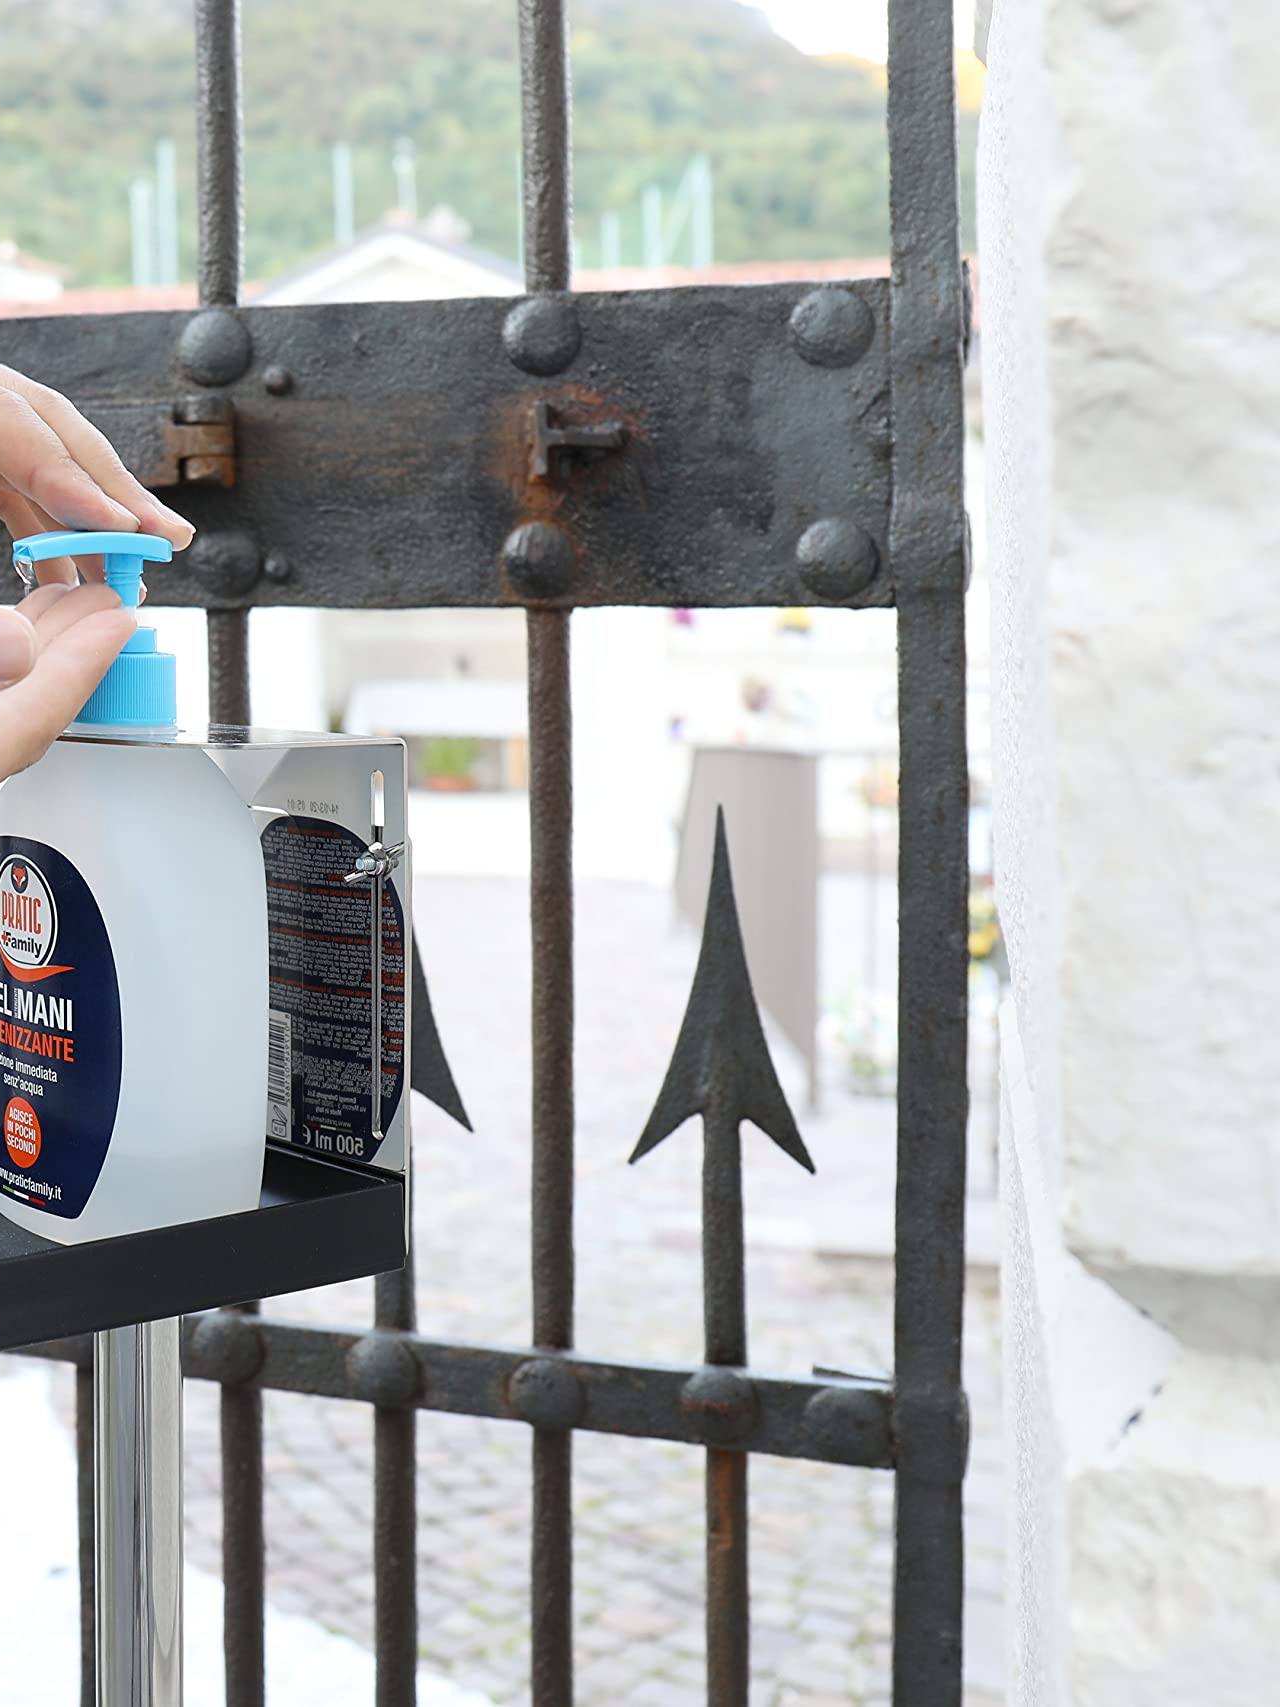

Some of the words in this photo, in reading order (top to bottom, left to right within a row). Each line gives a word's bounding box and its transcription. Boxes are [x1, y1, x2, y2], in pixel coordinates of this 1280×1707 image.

[1, 890, 42, 934] PRATIC
[17, 988, 73, 1032] MANI
[15, 1058, 58, 1083] immediata
[3, 1072, 44, 1097] senz'acqua
[8, 1107, 34, 1127] AGISCE
[7, 1120, 14, 1132] IN
[15, 1123, 36, 1141] POCHI
[7, 1134, 36, 1155] SECONDI
